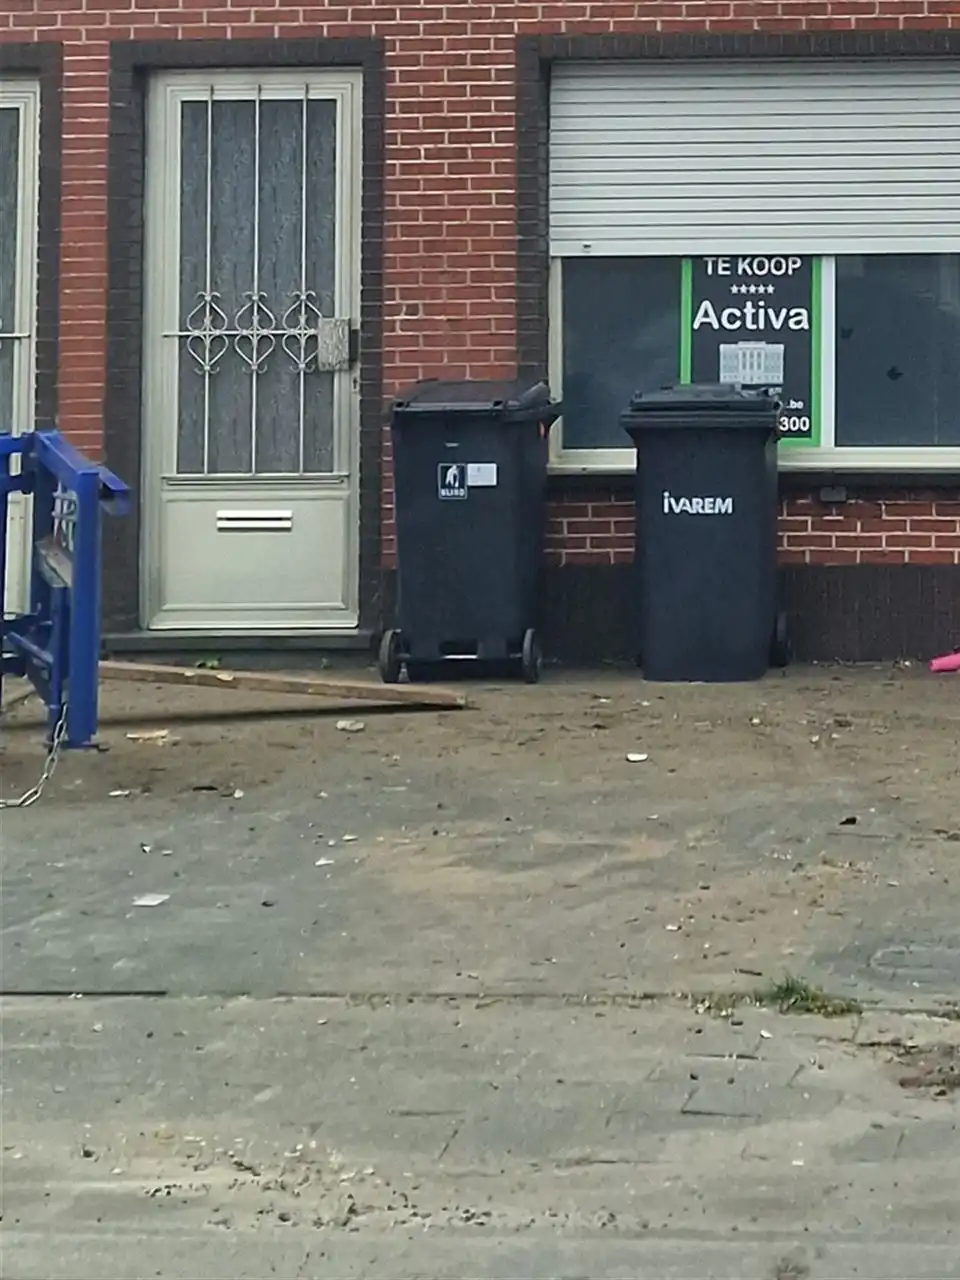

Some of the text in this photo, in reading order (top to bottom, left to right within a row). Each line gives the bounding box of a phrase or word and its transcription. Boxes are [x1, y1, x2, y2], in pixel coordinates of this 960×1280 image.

[703, 257, 802, 275] TE KOOP
[693, 300, 809, 330] Activa
[779, 416, 810, 431] 300
